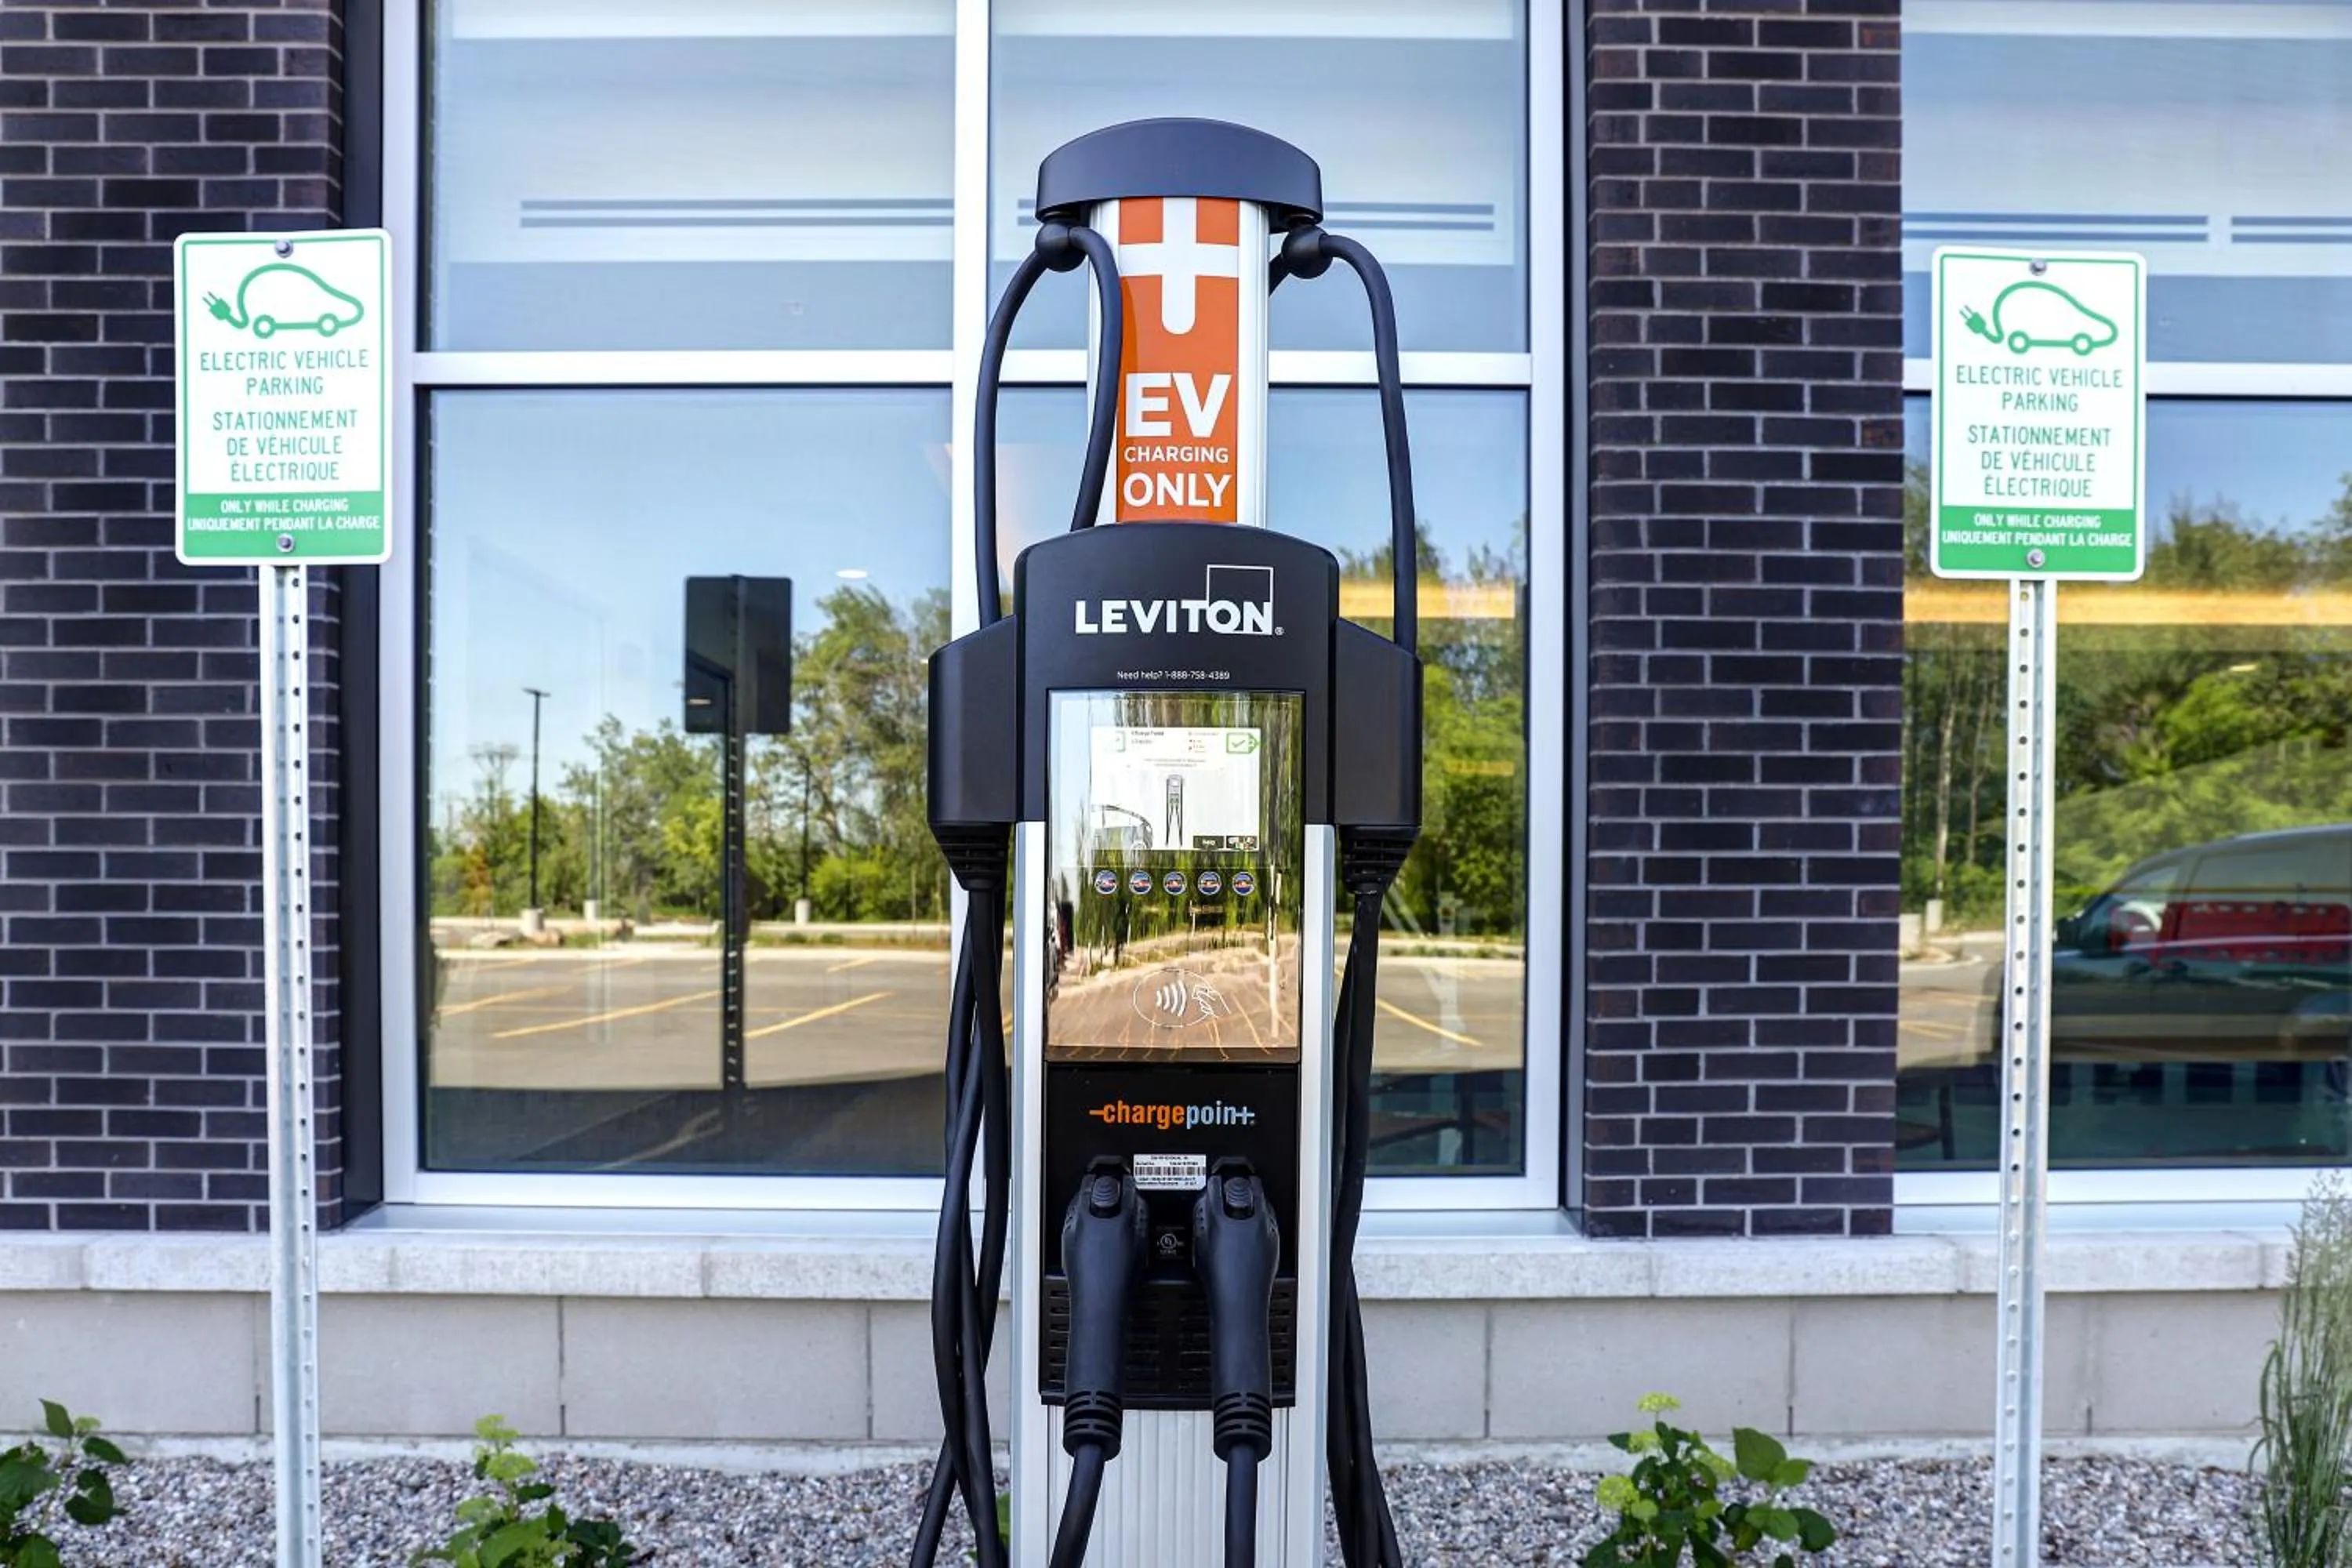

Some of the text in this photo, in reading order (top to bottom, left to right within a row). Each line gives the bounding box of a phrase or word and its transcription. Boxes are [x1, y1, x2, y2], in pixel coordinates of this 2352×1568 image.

[200, 349, 369, 372] ELECTRIC VEHICLE
[246, 376, 324, 396] PARKING
[1956, 365, 2124, 388] ELECTRIC VEHICLE
[1125, 372, 1231, 438] EV
[2002, 392, 2078, 412] PARKING
[212, 409, 358, 431] STATIONNEMENT
[227, 434, 343, 456] DE VÉHICULE
[1968, 425, 2111, 447] STATIONNEMENT
[1123, 446, 1229, 464] CHARGING
[1981, 449, 2096, 473] DE VÉHICULE
[231, 459, 339, 482] ÉLECTRIQUE
[1123, 472, 1232, 507] ONLY
[1984, 475, 2092, 498] ÉLECTRIQUE
[220, 498, 349, 514] ONLY WHILE CHARGING
[187, 515, 381, 531] UNIQUEMENT PENDANT LA CHARGE
[1974, 513, 2101, 528] ONLY WHILE CHARGING
[1942, 530, 2132, 546] UNIQUEMENT PENDANT LA CHARGE
[1075, 600, 1274, 636] LEVITON
[1117, 670, 1139, 680] Need
[1141, 670, 1163, 681] help?
